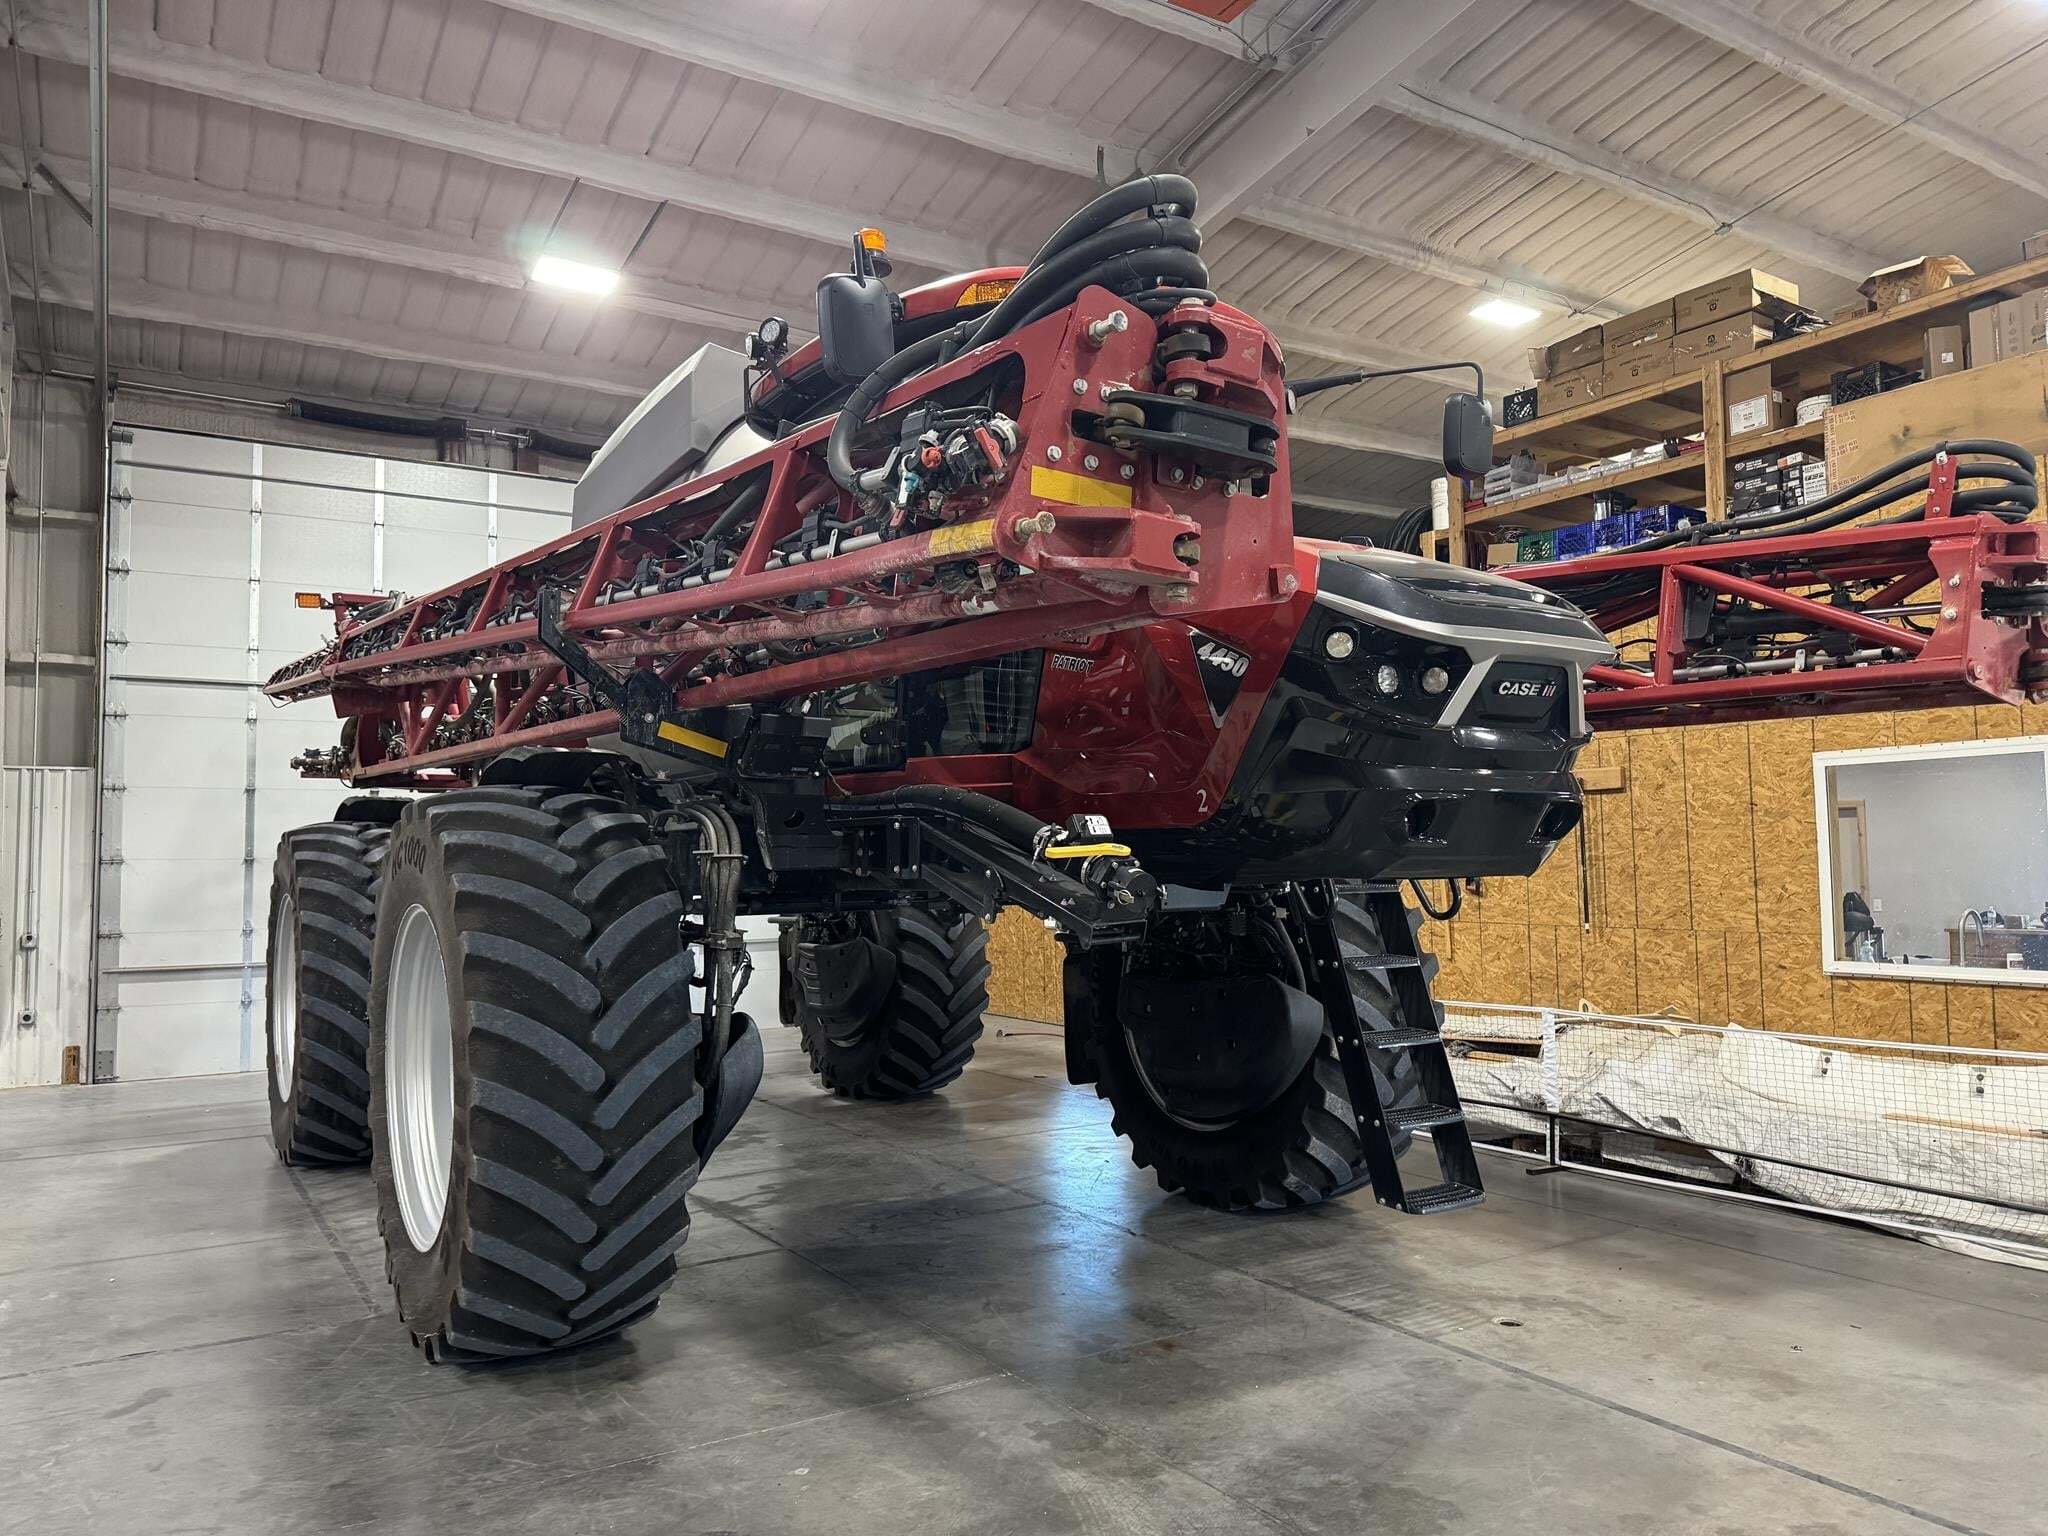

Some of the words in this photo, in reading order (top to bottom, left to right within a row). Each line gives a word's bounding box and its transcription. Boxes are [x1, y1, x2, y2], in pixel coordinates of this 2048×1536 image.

[1050, 653, 1095, 673] PATRIOT
[1196, 641, 1250, 678] 4450
[1498, 681, 1541, 696] CASE
[1196, 788, 1208, 812] 2
